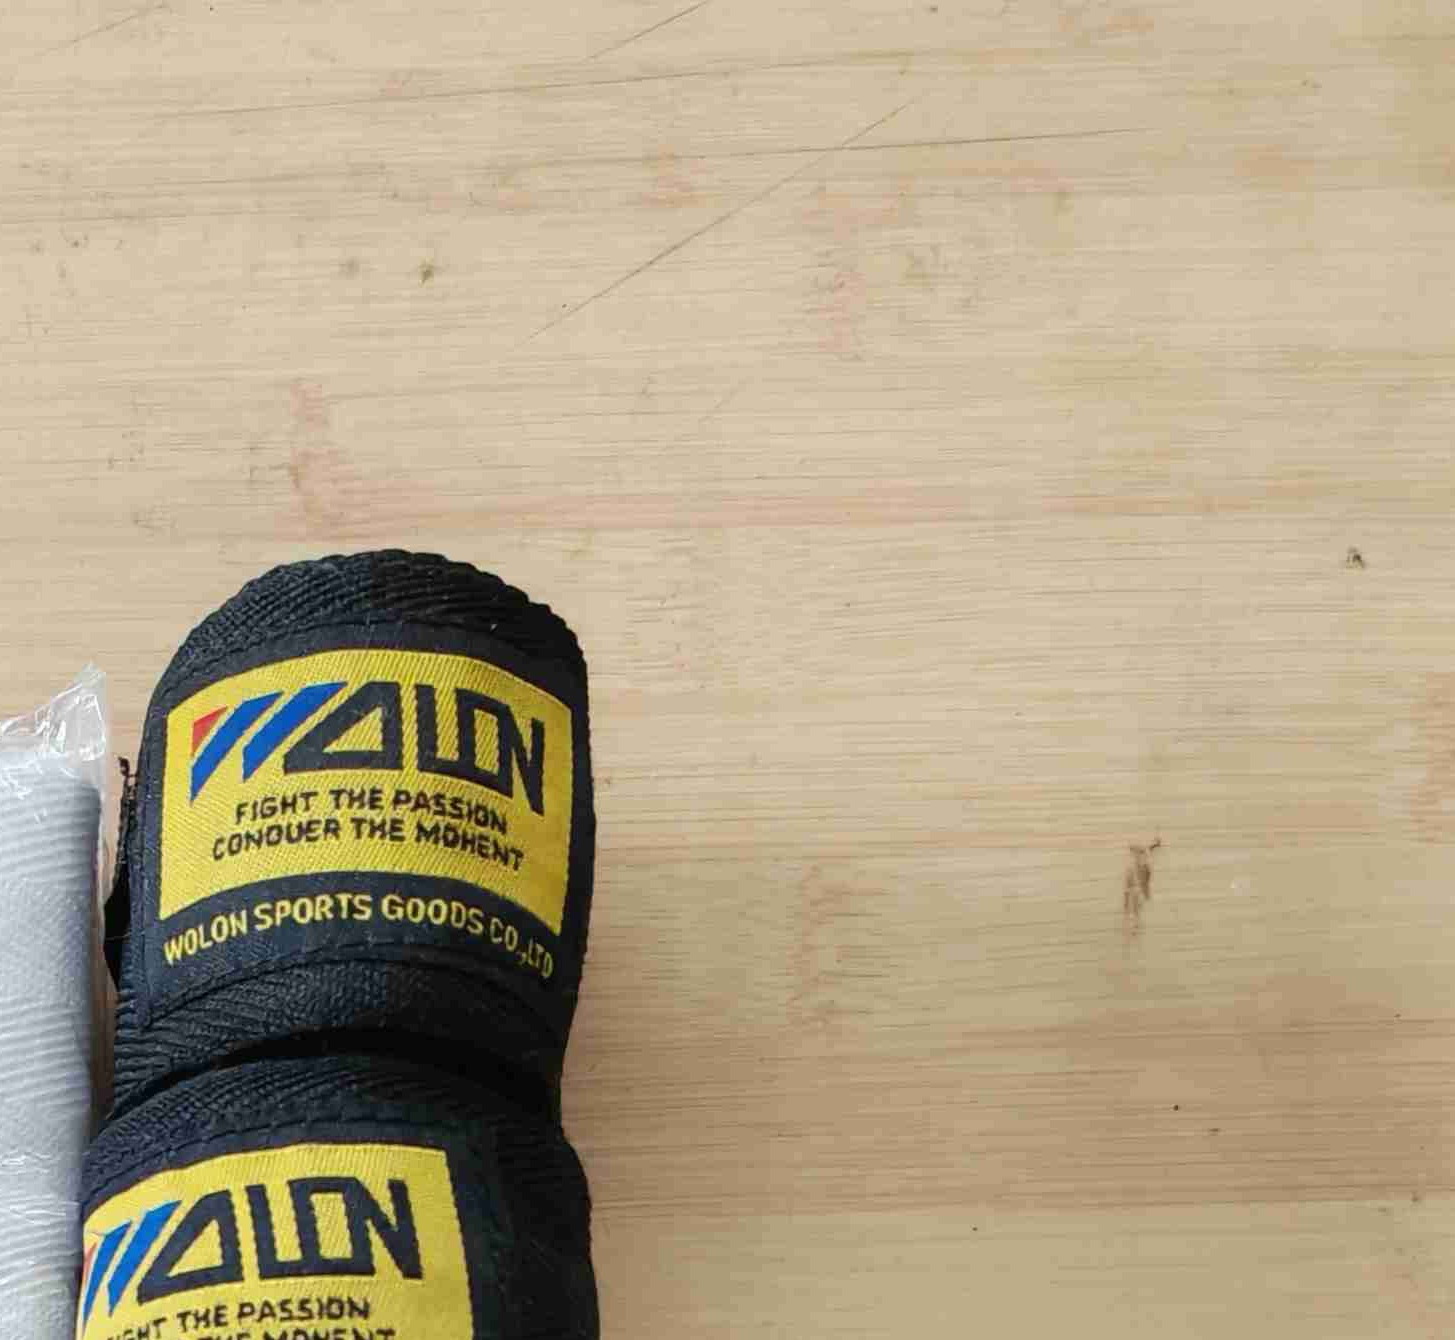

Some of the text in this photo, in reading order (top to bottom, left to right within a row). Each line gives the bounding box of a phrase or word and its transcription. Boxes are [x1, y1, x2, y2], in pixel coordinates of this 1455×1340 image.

[235, 785, 508, 836] FIGHT THE PASSION
[349, 817, 406, 842] THE
[163, 907, 248, 965] WOLON
[254, 891, 373, 934] SPORTS
[381, 891, 485, 938] GOODS
[176, 1304, 229, 1333] THE
[236, 1296, 371, 1324] PASSION
